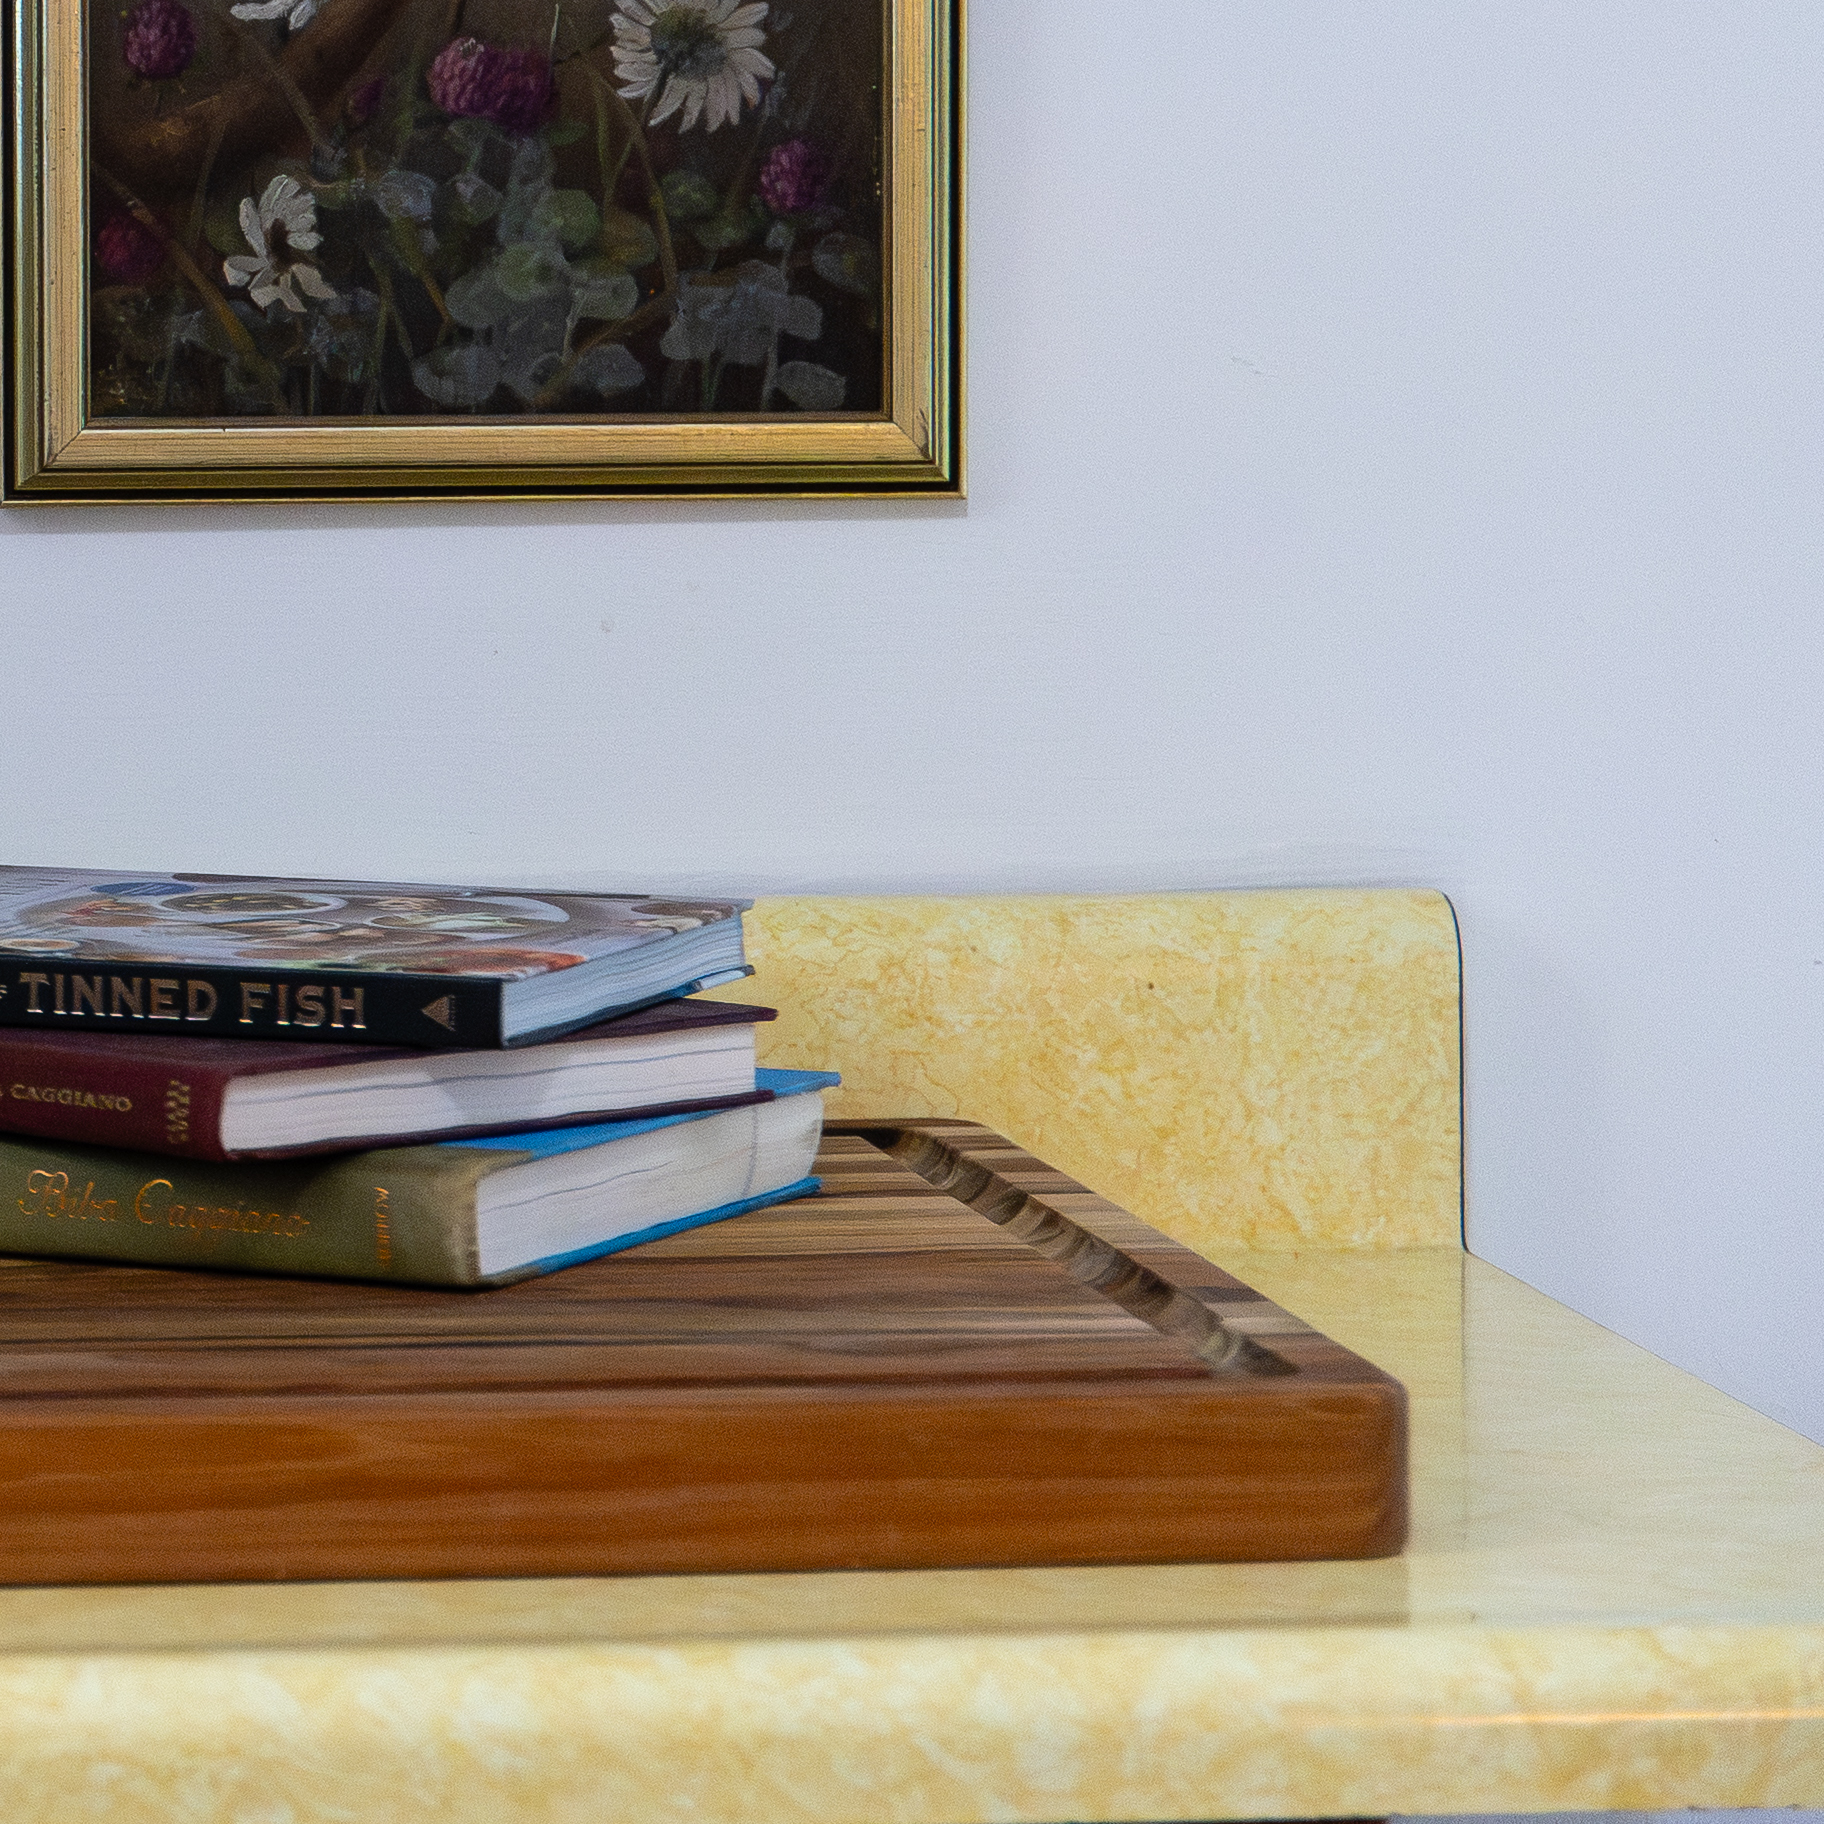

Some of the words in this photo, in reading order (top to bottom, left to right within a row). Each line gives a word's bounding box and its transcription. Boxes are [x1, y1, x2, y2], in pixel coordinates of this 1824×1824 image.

[19, 972, 219, 1021] TINNED
[240, 981, 367, 1030] FISH
[9, 1083, 133, 1113] CAGGIANO
[18, 1169, 118, 1222] Biba
[135, 1179, 311, 1256] Caggiano
